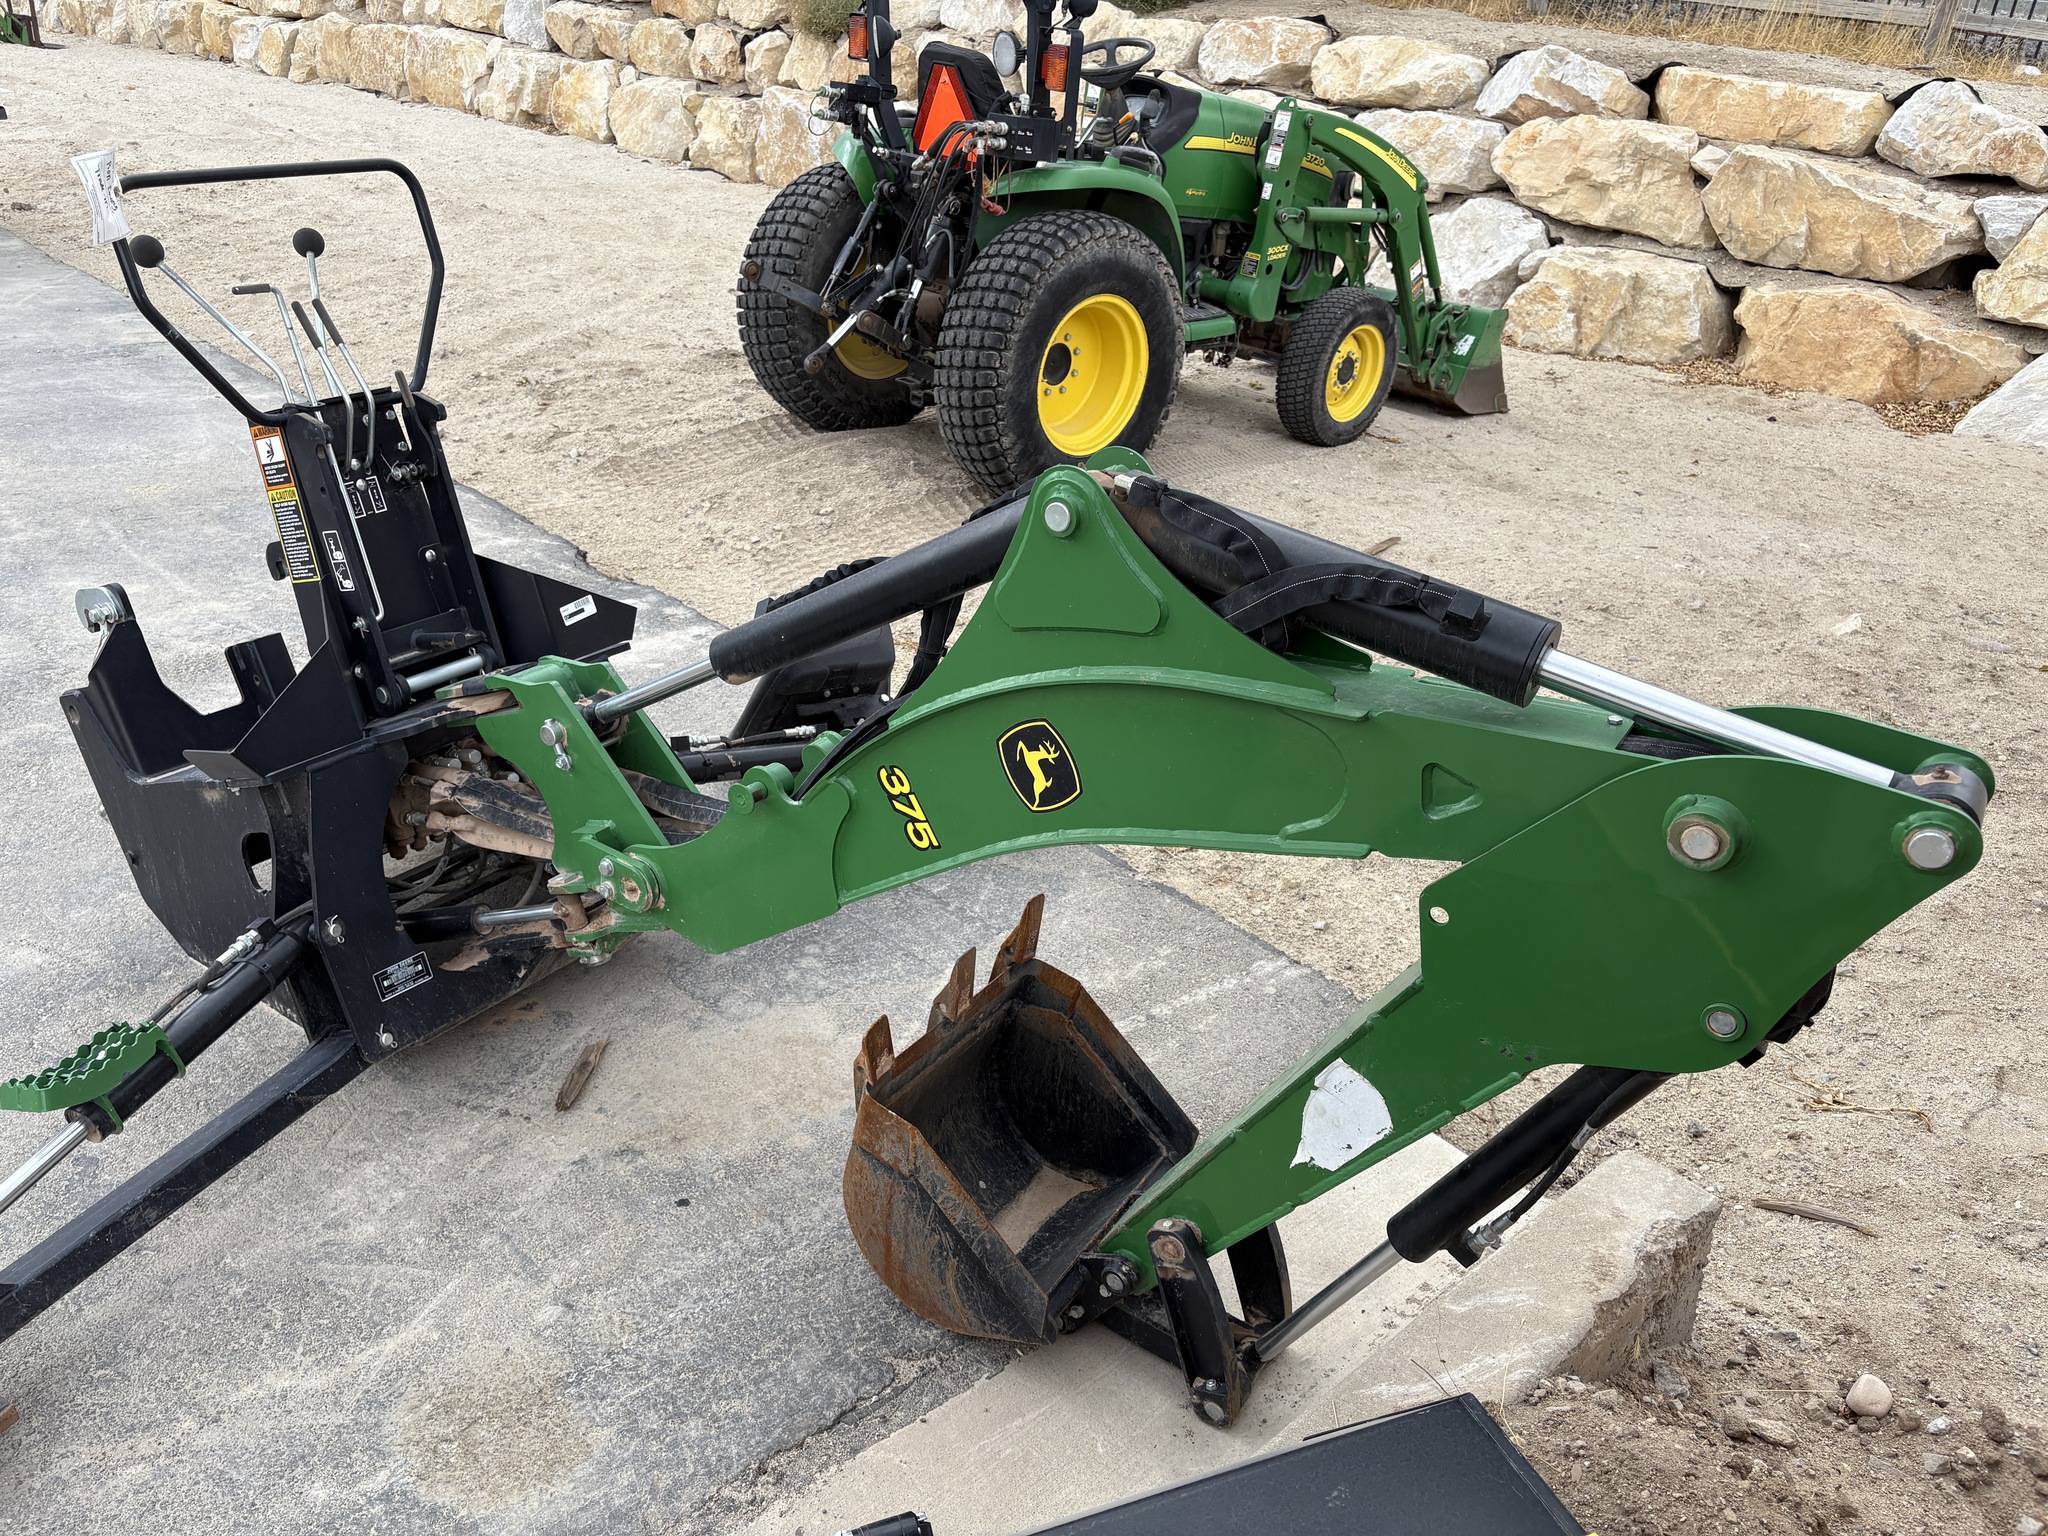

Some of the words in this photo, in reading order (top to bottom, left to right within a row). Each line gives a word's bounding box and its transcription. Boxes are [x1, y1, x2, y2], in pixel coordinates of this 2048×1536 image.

[1227, 131, 1253, 147] JOHN
[1306, 152, 1325, 167] 3720
[1267, 244, 1289, 255] 300CX
[1267, 252, 1286, 261] LOADER
[276, 489, 297, 501] CAUTION
[877, 765, 941, 851] 375
